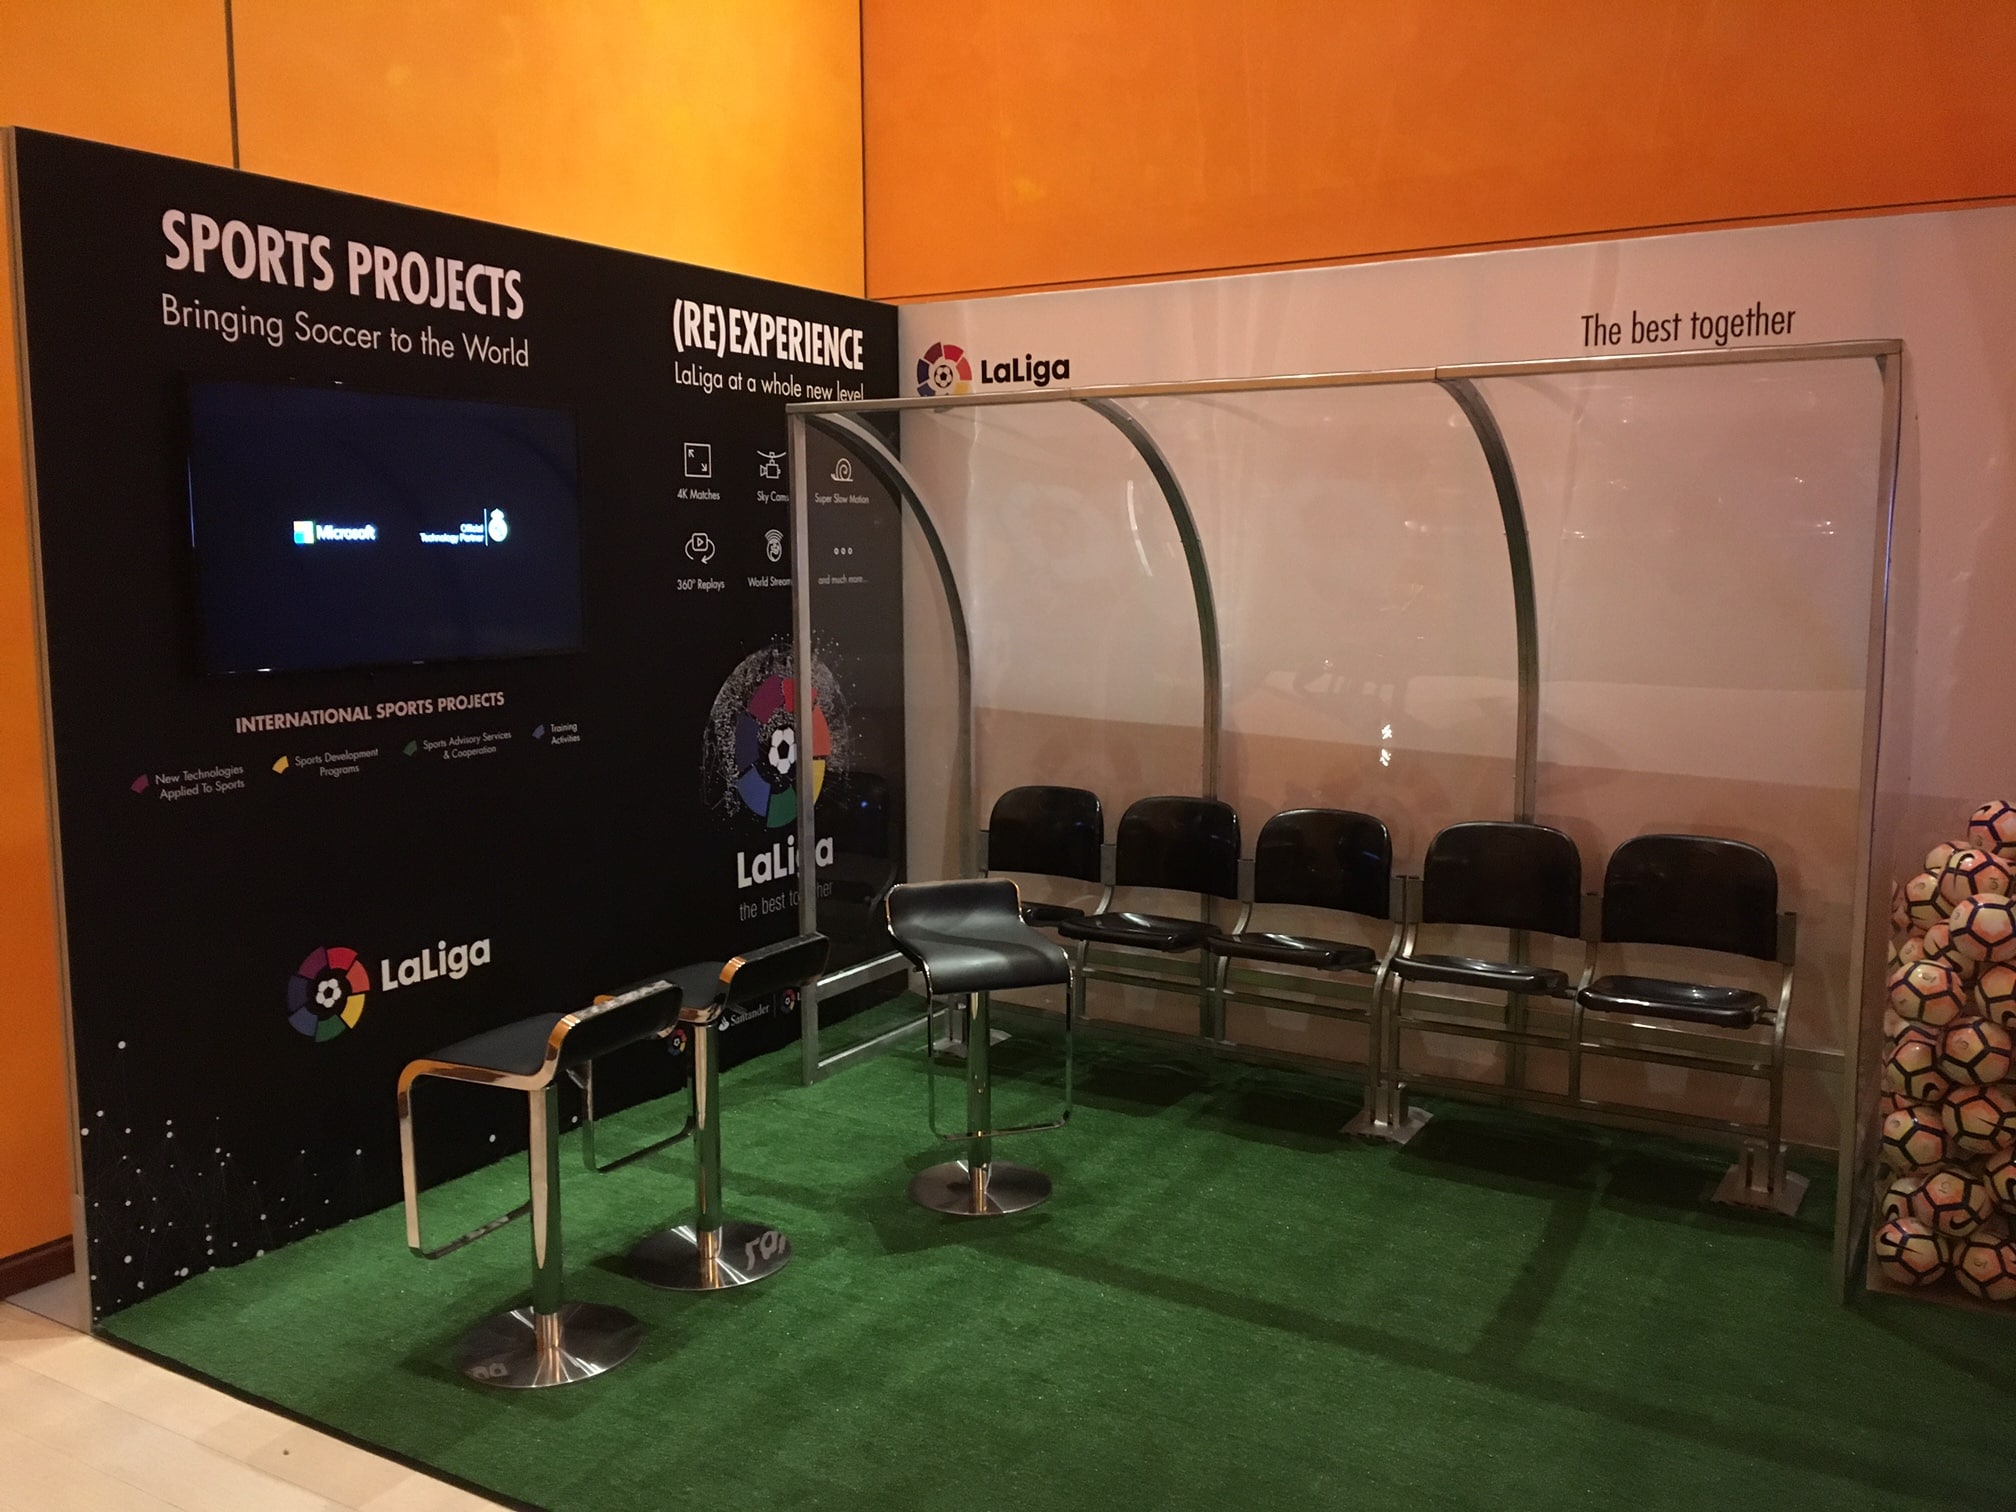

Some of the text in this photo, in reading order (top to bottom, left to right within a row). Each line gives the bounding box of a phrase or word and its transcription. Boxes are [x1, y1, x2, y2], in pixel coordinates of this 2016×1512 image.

[162, 208, 524, 320] SPORTS PROJECTS
[161, 293, 529, 367] Bringing Soccer to the World
[673, 298, 864, 371] (RE)EXPERIENCE
[1581, 301, 1796, 347] The best together
[981, 353, 1070, 387] LaLiga
[674, 361, 864, 401] LaLiga at a whole new level
[677, 488, 721, 501] 4K Matches
[757, 490, 769, 504] Sky
[814, 493, 870, 505] Super Slow Motion
[316, 523, 377, 541] Microsoft
[677, 578, 726, 592] 360° Replays
[747, 576, 768, 587] World
[818, 574, 831, 585] and
[831, 574, 847, 585] much
[235, 691, 505, 734] INTERNATIONAL SPORTS PROJECTS
[550, 722, 578, 734] Training
[423, 731, 512, 752] Sports Advisory Services
[551, 734, 581, 745] Activities
[295, 748, 379, 768] Sports Development
[443, 745, 497, 760] & Cooperation
[155, 764, 244, 785] New Technologies
[319, 764, 360, 778] Programs
[160, 779, 245, 801] Applied To Sports
[737, 834, 834, 889] LaLia
[740, 881, 834, 922] the best toher
[381, 938, 491, 992] LaLiga
[730, 1003, 770, 1027] Santander
